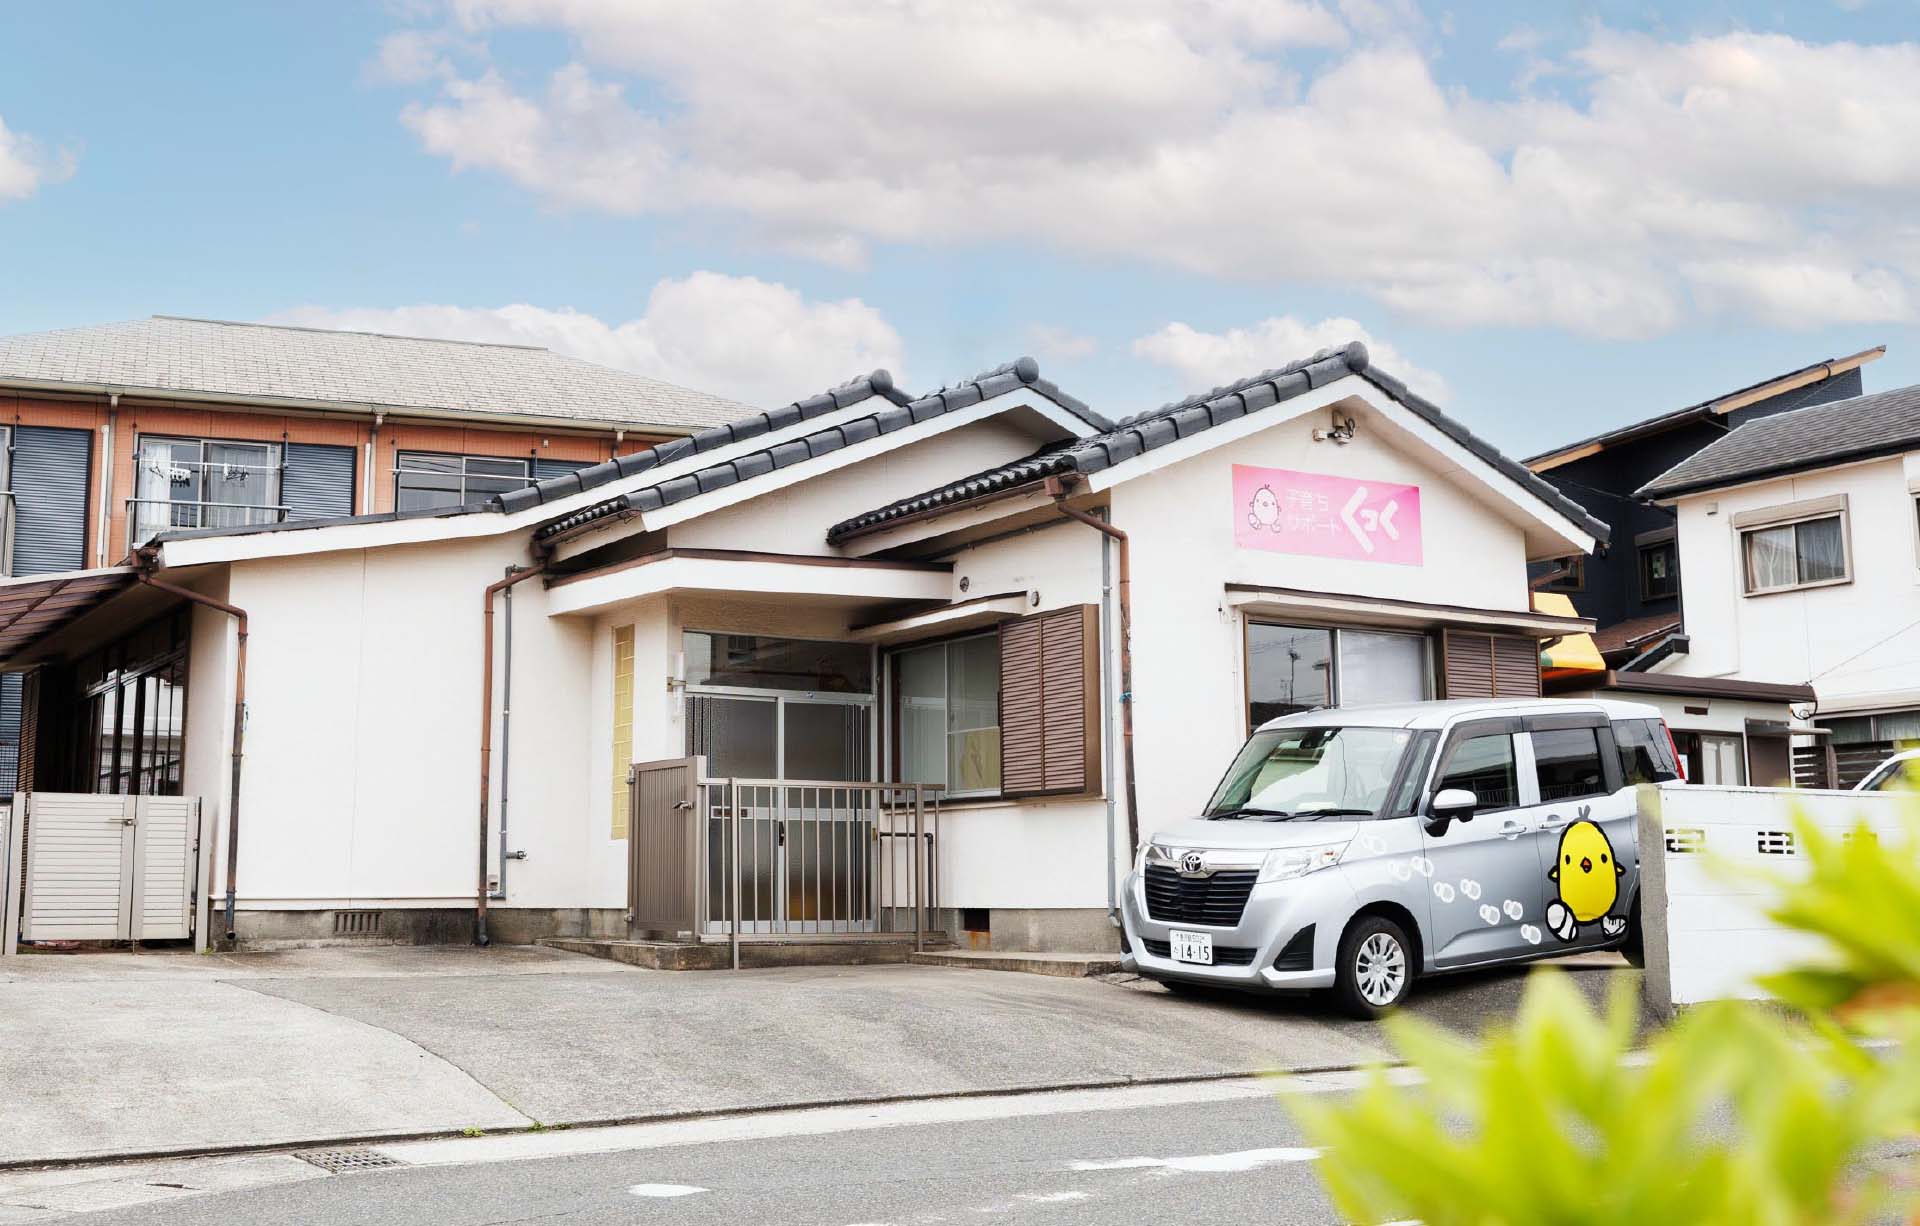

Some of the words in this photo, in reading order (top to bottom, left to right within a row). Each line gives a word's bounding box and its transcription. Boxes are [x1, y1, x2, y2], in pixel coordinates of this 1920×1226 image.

[1286, 514, 1343, 537] サポート
[1340, 486, 1400, 554] くっく
